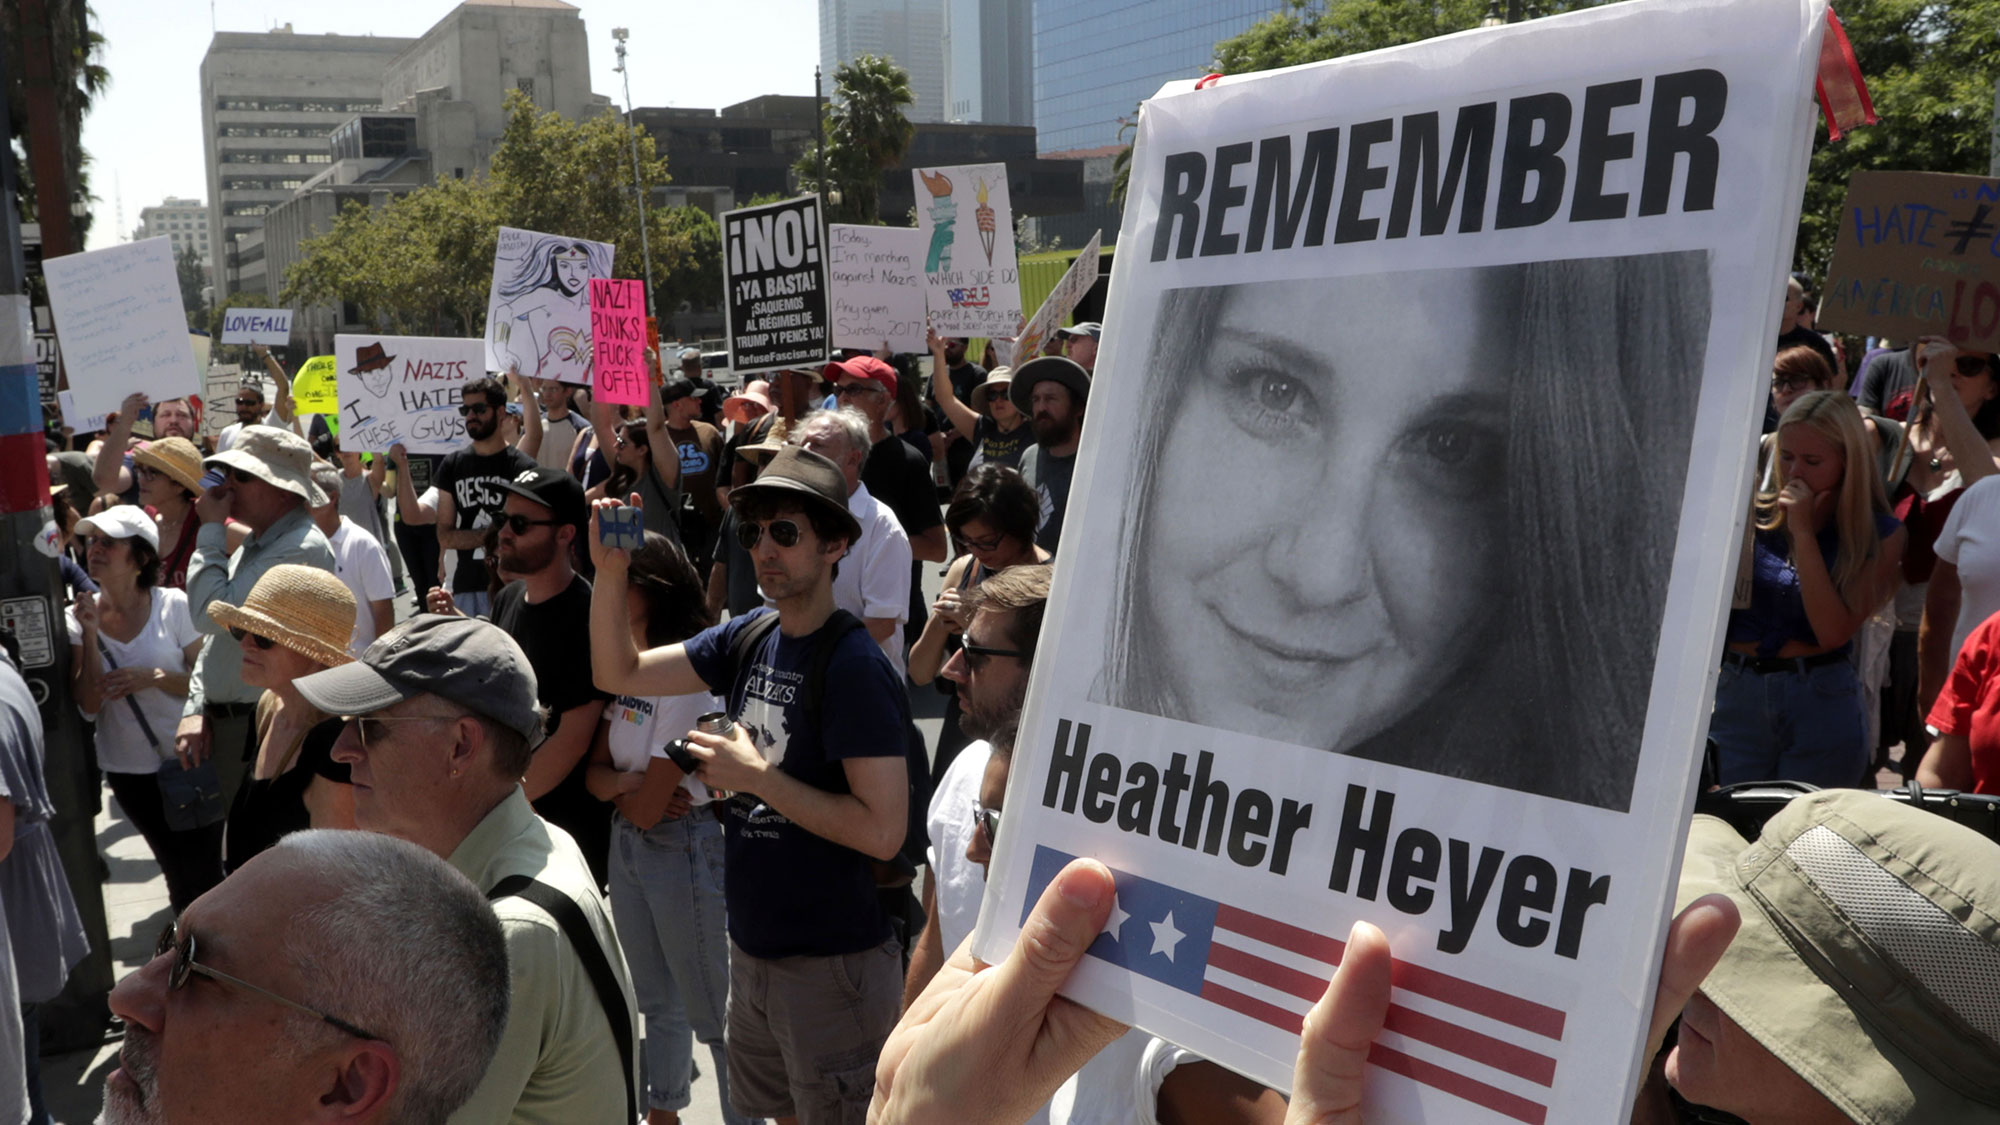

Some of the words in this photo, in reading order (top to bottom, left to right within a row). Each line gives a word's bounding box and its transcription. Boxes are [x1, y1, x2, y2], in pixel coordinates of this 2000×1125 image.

[1150, 68, 1728, 263] REMEMBER
[1854, 203, 1947, 248] HATE
[730, 205, 819, 276] ¡NO!
[831, 245, 858, 264] I'm
[864, 250, 911, 271] marching
[765, 270, 816, 298] BASTA!
[832, 267, 875, 288] against
[881, 270, 918, 287] Nazis
[926, 271, 964, 285] WHICH
[970, 270, 995, 285] SIDE
[1001, 268, 1017, 284] DO
[593, 281, 632, 309] NAZI
[947, 286, 990, 309] YOU
[746, 319, 757, 332] AL
[759, 313, 801, 330] RÉGIMEN
[801, 311, 813, 325] DE
[836, 298, 860, 320] Any
[930, 310, 959, 321] CARRY
[963, 311, 970, 319] A
[975, 310, 1003, 322] TORCH
[1948, 280, 2000, 340] LO
[225, 316, 261, 332] LOVE
[263, 316, 289, 332] ALL
[592, 311, 640, 341] PUNKS
[837, 317, 886, 341] Sunday
[887, 320, 921, 338] 2017
[736, 333, 769, 349] TRUMP
[771, 332, 778, 345] Y
[779, 328, 808, 343] PENCE
[809, 326, 825, 340] YA!
[598, 341, 634, 366] FUCK
[739, 348, 824, 365] RefuseFascism.org
[601, 369, 642, 398] OFF!
[344, 399, 371, 428] I
[400, 387, 464, 411] HATE
[350, 420, 401, 450] THESE
[1042, 718, 1313, 876] Heather
[1328, 783, 1612, 960] Heyer
